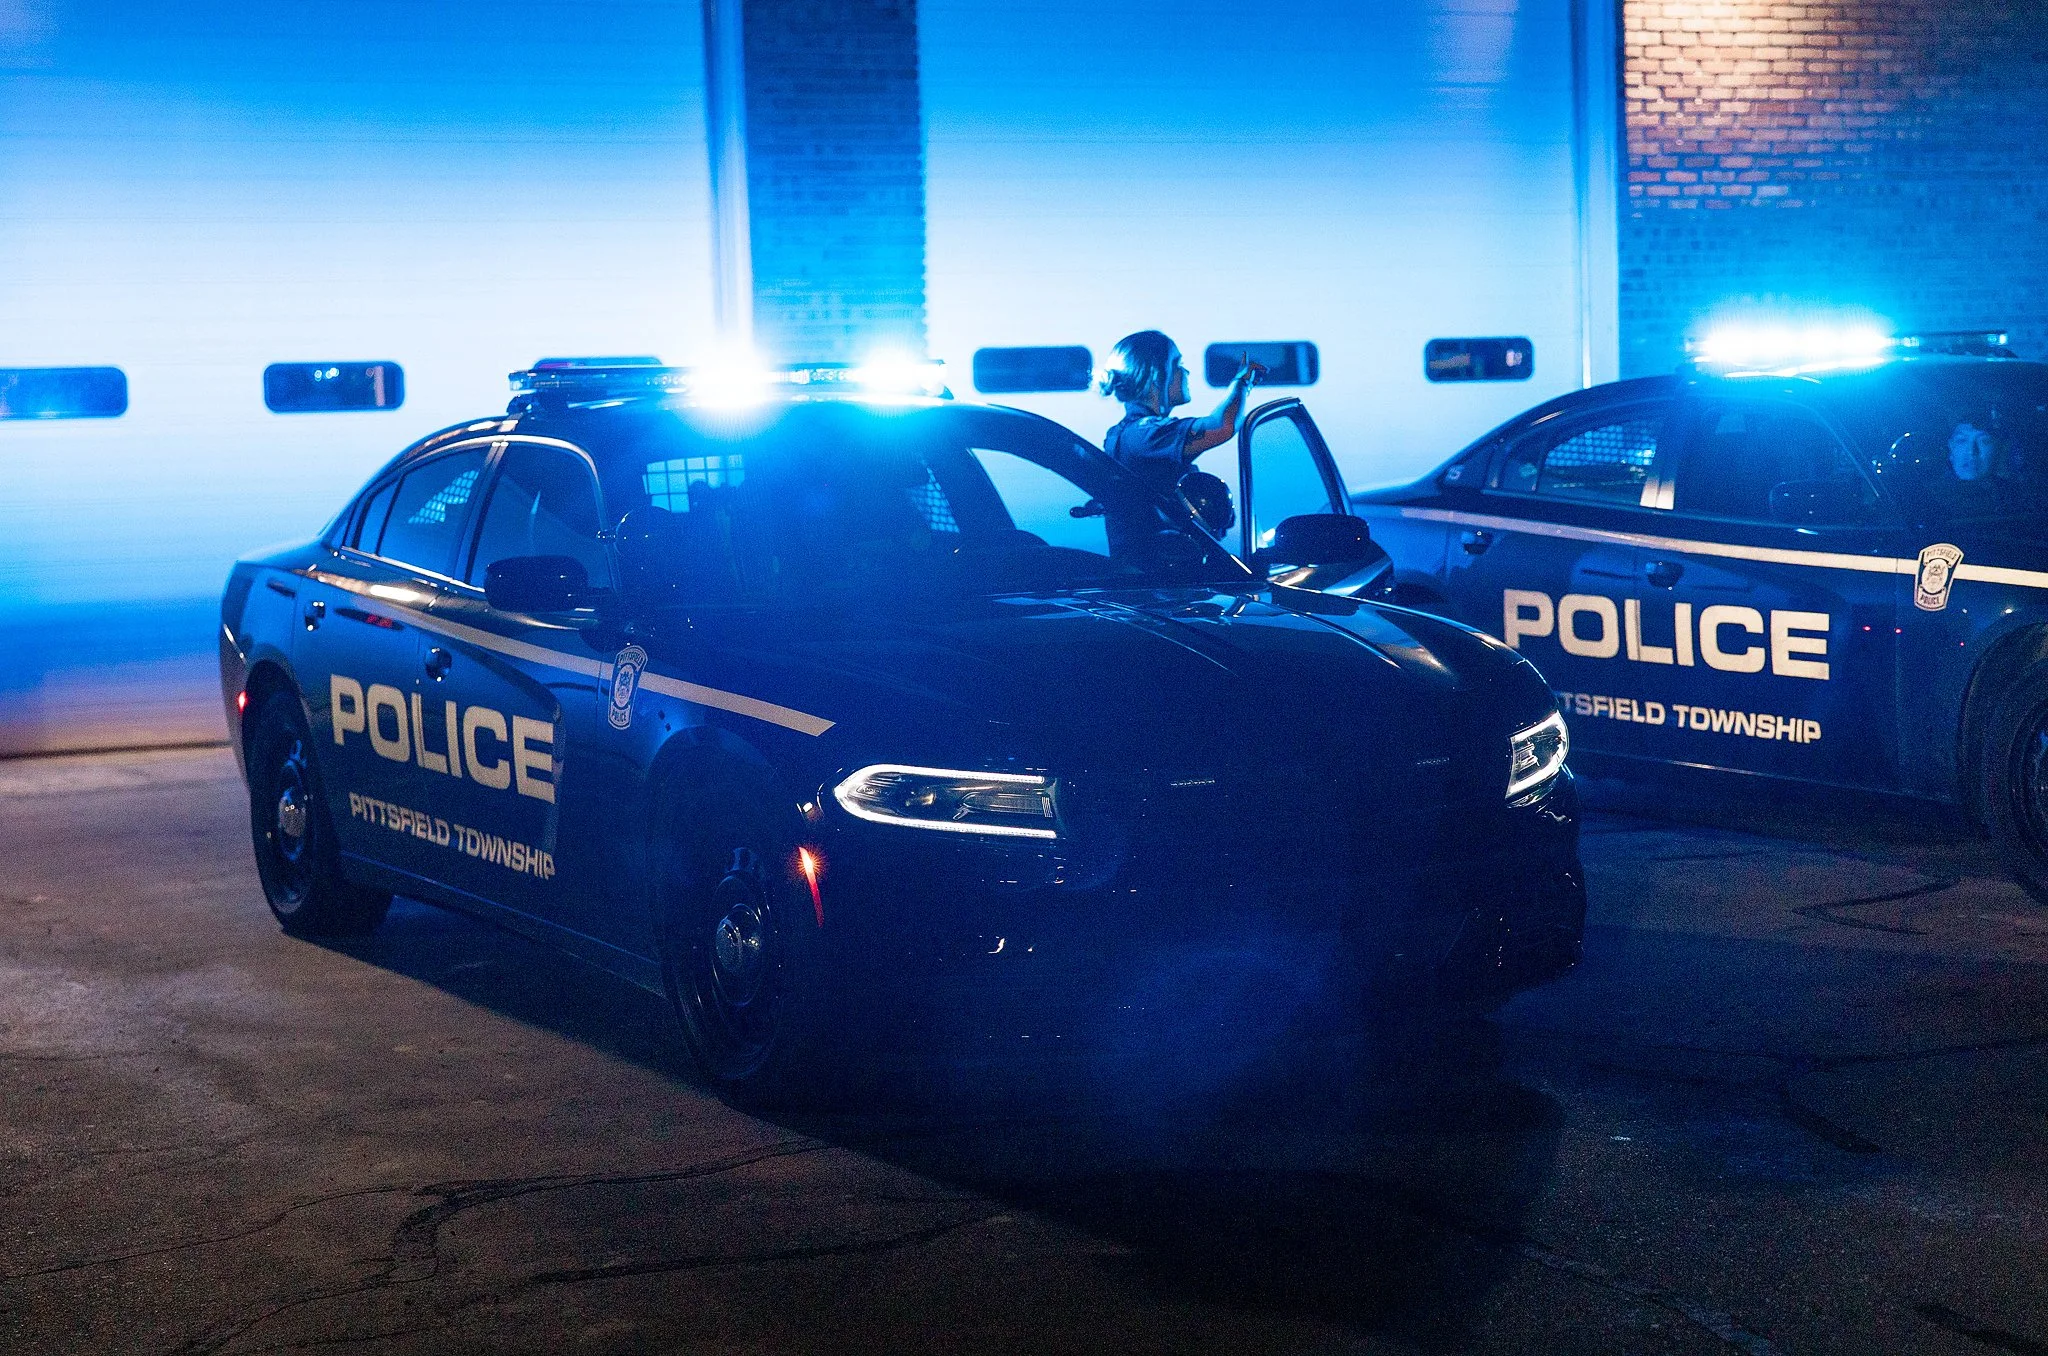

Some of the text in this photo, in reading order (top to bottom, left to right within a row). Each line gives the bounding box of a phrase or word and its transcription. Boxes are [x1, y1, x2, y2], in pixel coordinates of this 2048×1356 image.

[1503, 588, 1830, 681] POLICE
[330, 673, 556, 804] POLICE
[1672, 704, 1822, 744] TOWNSHIP
[348, 792, 556, 881] PITTSFIELD TOWNSHIP
